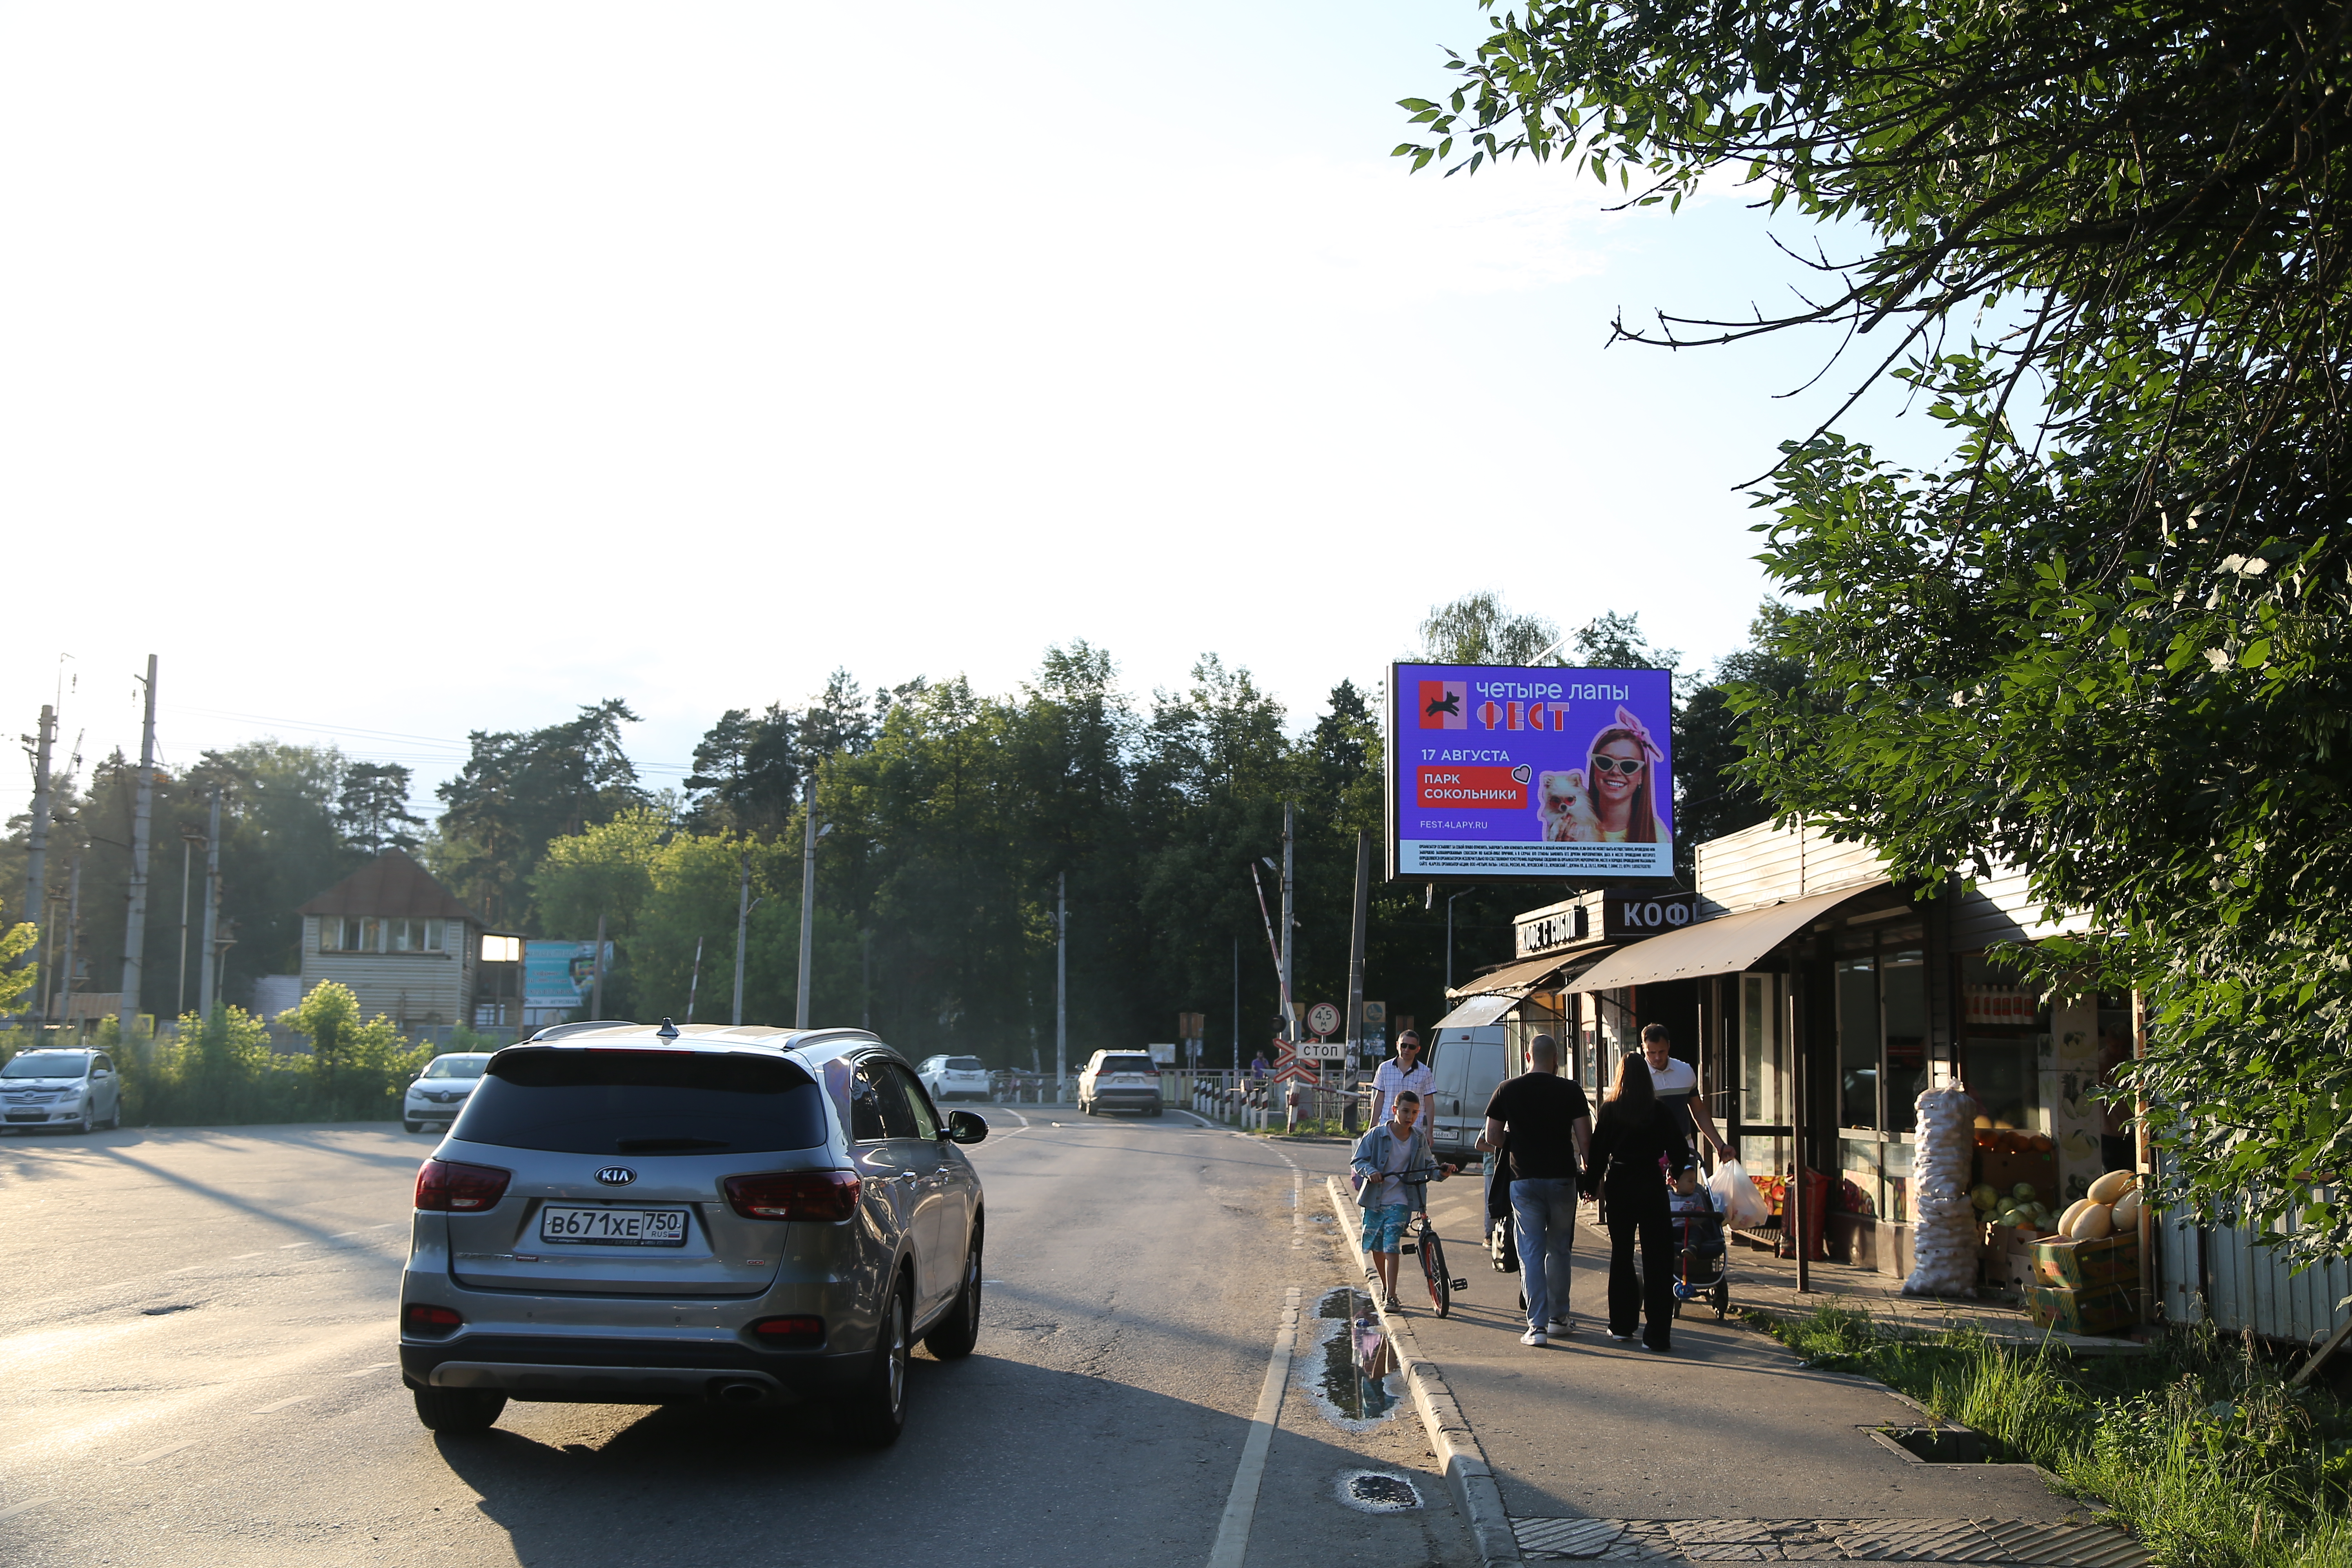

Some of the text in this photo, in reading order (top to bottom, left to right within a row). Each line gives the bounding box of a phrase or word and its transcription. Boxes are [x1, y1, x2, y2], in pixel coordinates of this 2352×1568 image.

[1476, 682, 1629, 700] четыре лапы
[1477, 700, 1570, 731] ФЕСТ
[1421, 749, 1510, 762] 17 АВГУСТА
[1424, 773, 1461, 784] ПАРК
[1424, 788, 1517, 800] СОКОЛЬНИКИ
[1420, 820, 1488, 829] FEST.4LAPY.RU
[1523, 903, 1575, 951] КОФЕ С СОБОЙ
[1315, 1010, 1332, 1021] 4,5
[1303, 1046, 1338, 1056] СТОП
[602, 1170, 629, 1181] KIA
[645, 1212, 678, 1231] 750
